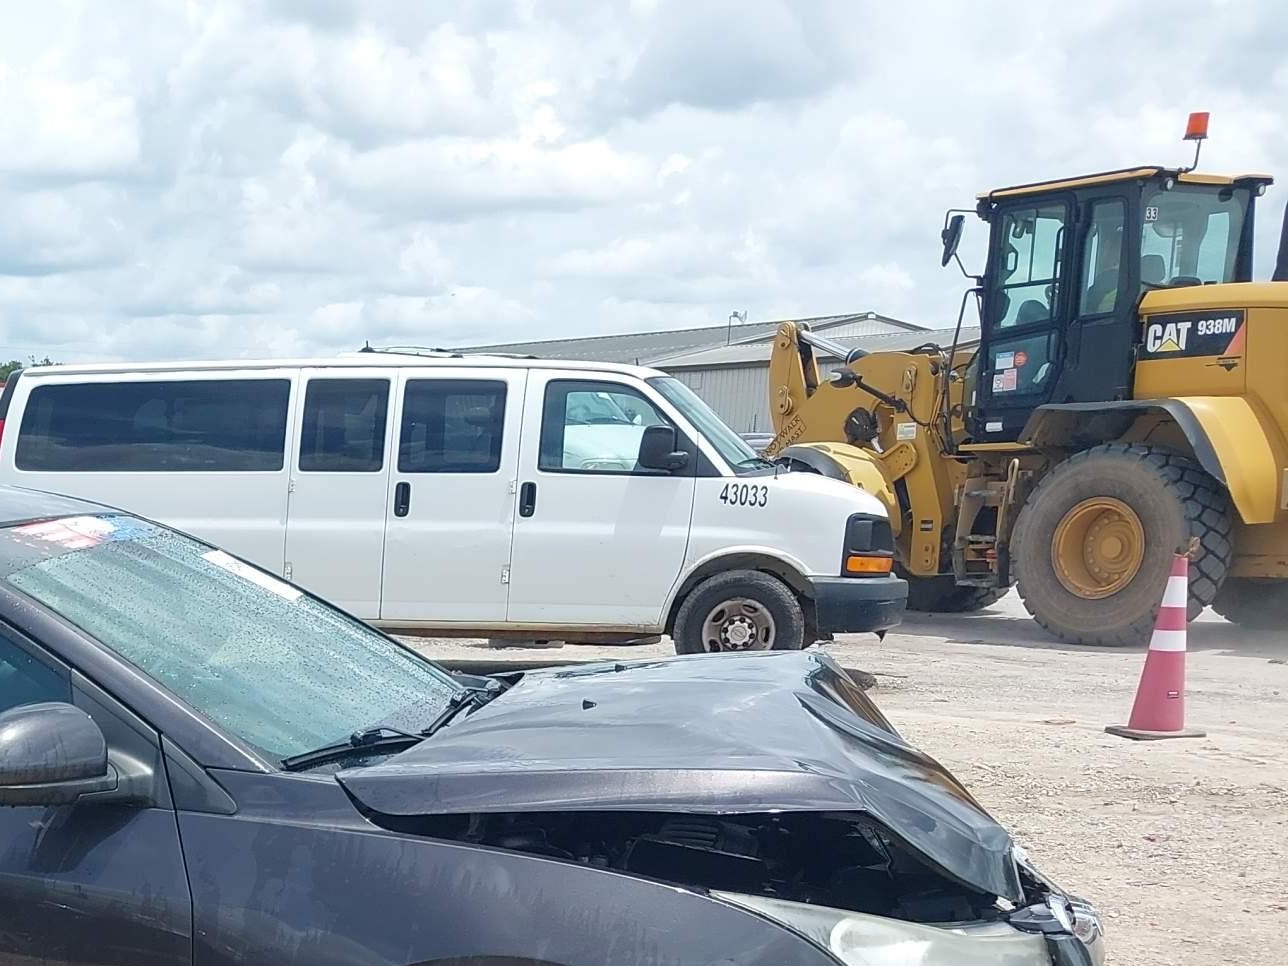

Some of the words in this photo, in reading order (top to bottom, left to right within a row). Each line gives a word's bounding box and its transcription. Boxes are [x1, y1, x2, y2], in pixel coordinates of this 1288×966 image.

[1146, 207, 1157, 219] 33
[1147, 321, 1192, 353] CAT
[1197, 318, 1237, 335] 938M
[720, 483, 768, 507] 43033
